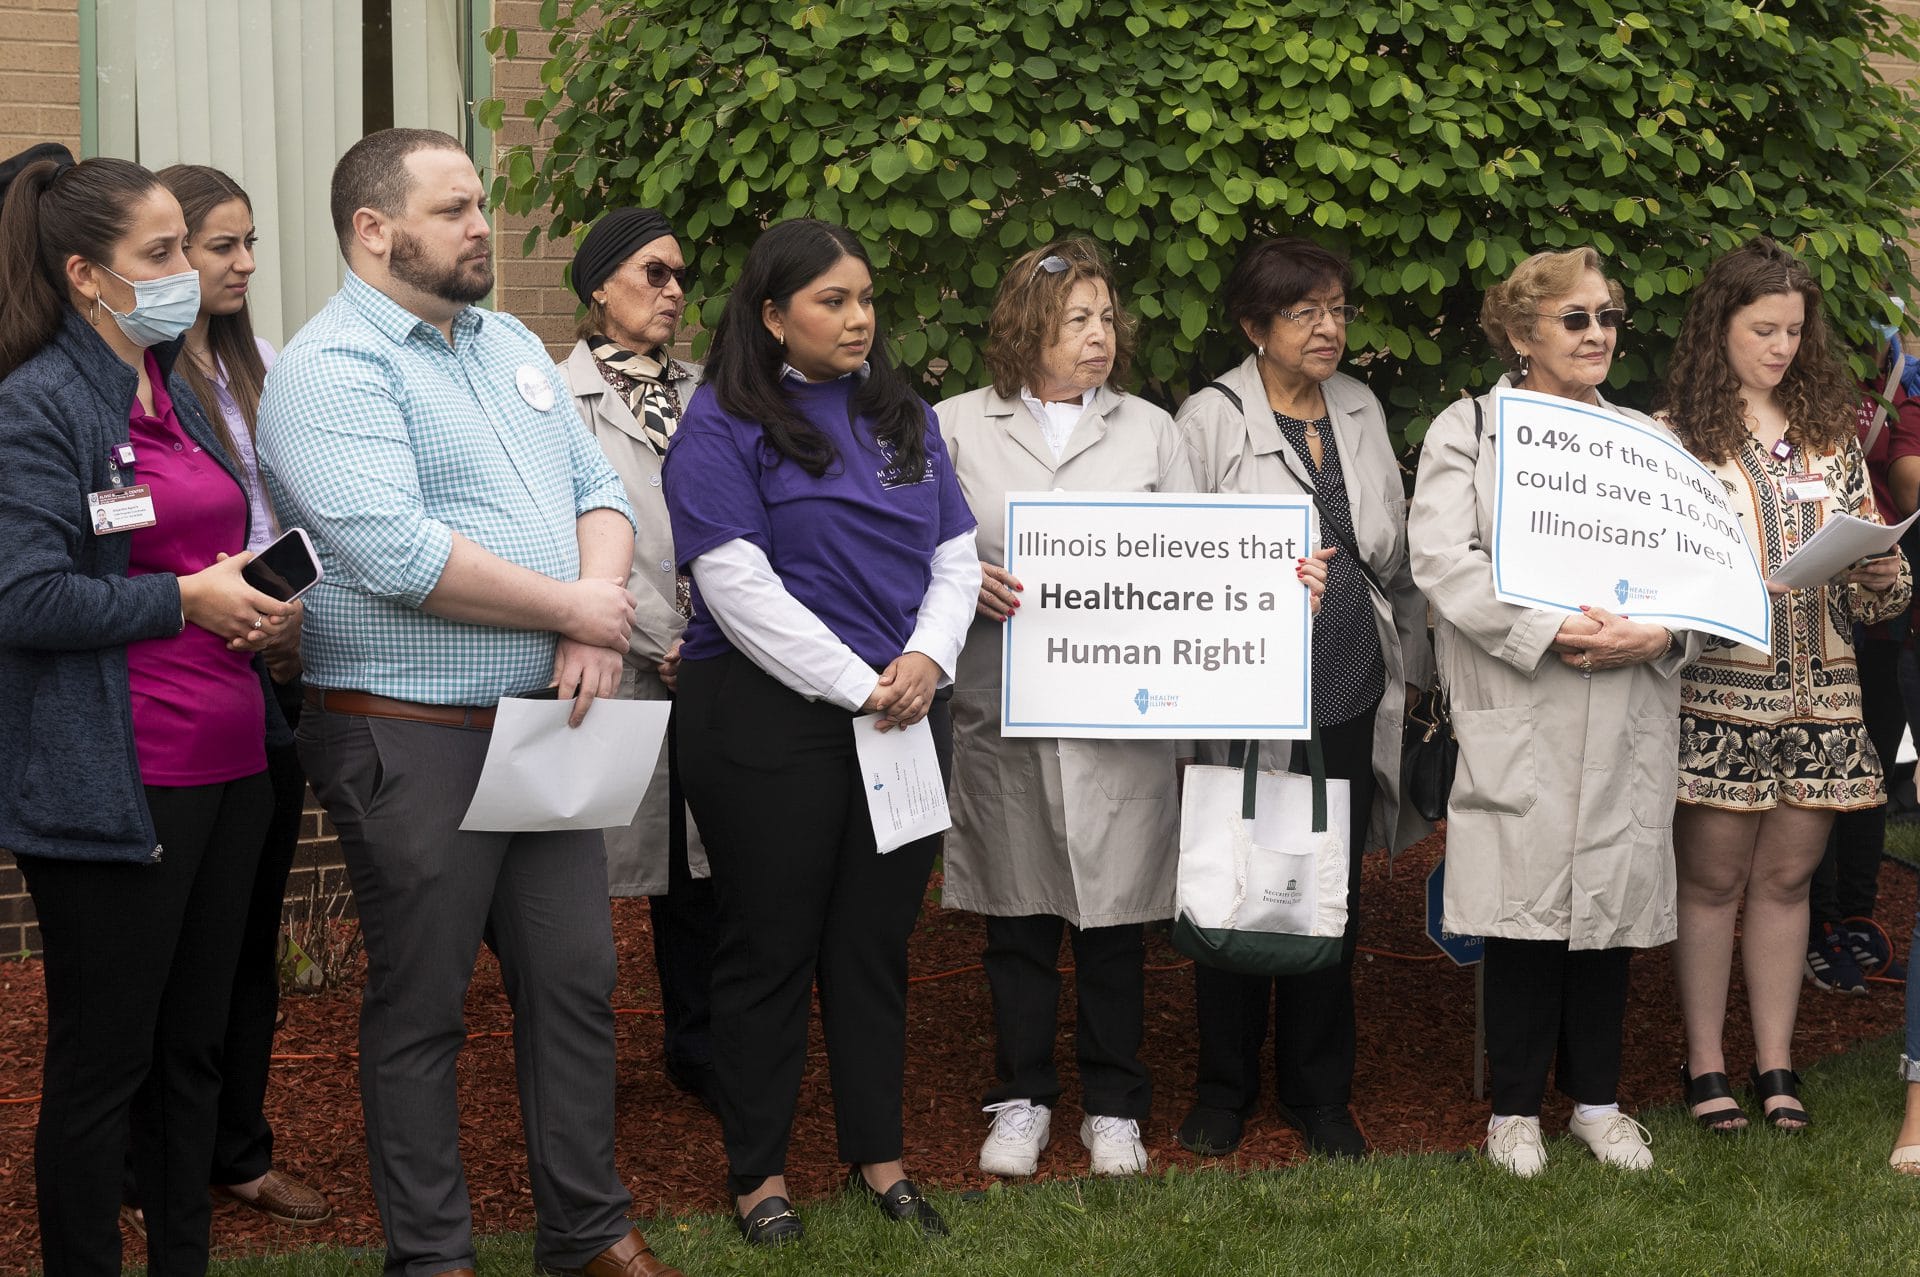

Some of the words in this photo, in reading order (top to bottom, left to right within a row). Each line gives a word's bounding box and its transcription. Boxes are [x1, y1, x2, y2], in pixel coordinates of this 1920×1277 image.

[1517, 425, 1581, 453] 0.4%
[1589, 440, 1614, 459] of
[1621, 446, 1658, 473] the
[1665, 460, 1731, 516] budget
[1516, 470, 1587, 495] could
[1596, 481, 1652, 506] save
[1660, 493, 1741, 545] 116,000
[1018, 531, 1106, 557] Illinois
[1116, 532, 1230, 559] believes
[1239, 535, 1296, 560] that
[1677, 530, 1734, 570] lives!
[1040, 582, 1214, 611] Healthcare
[1225, 585, 1248, 611] is
[1258, 591, 1275, 611] a
[1629, 587, 1659, 595] HEALTHY
[1047, 637, 1161, 665] Human
[1173, 637, 1266, 671] Right!
